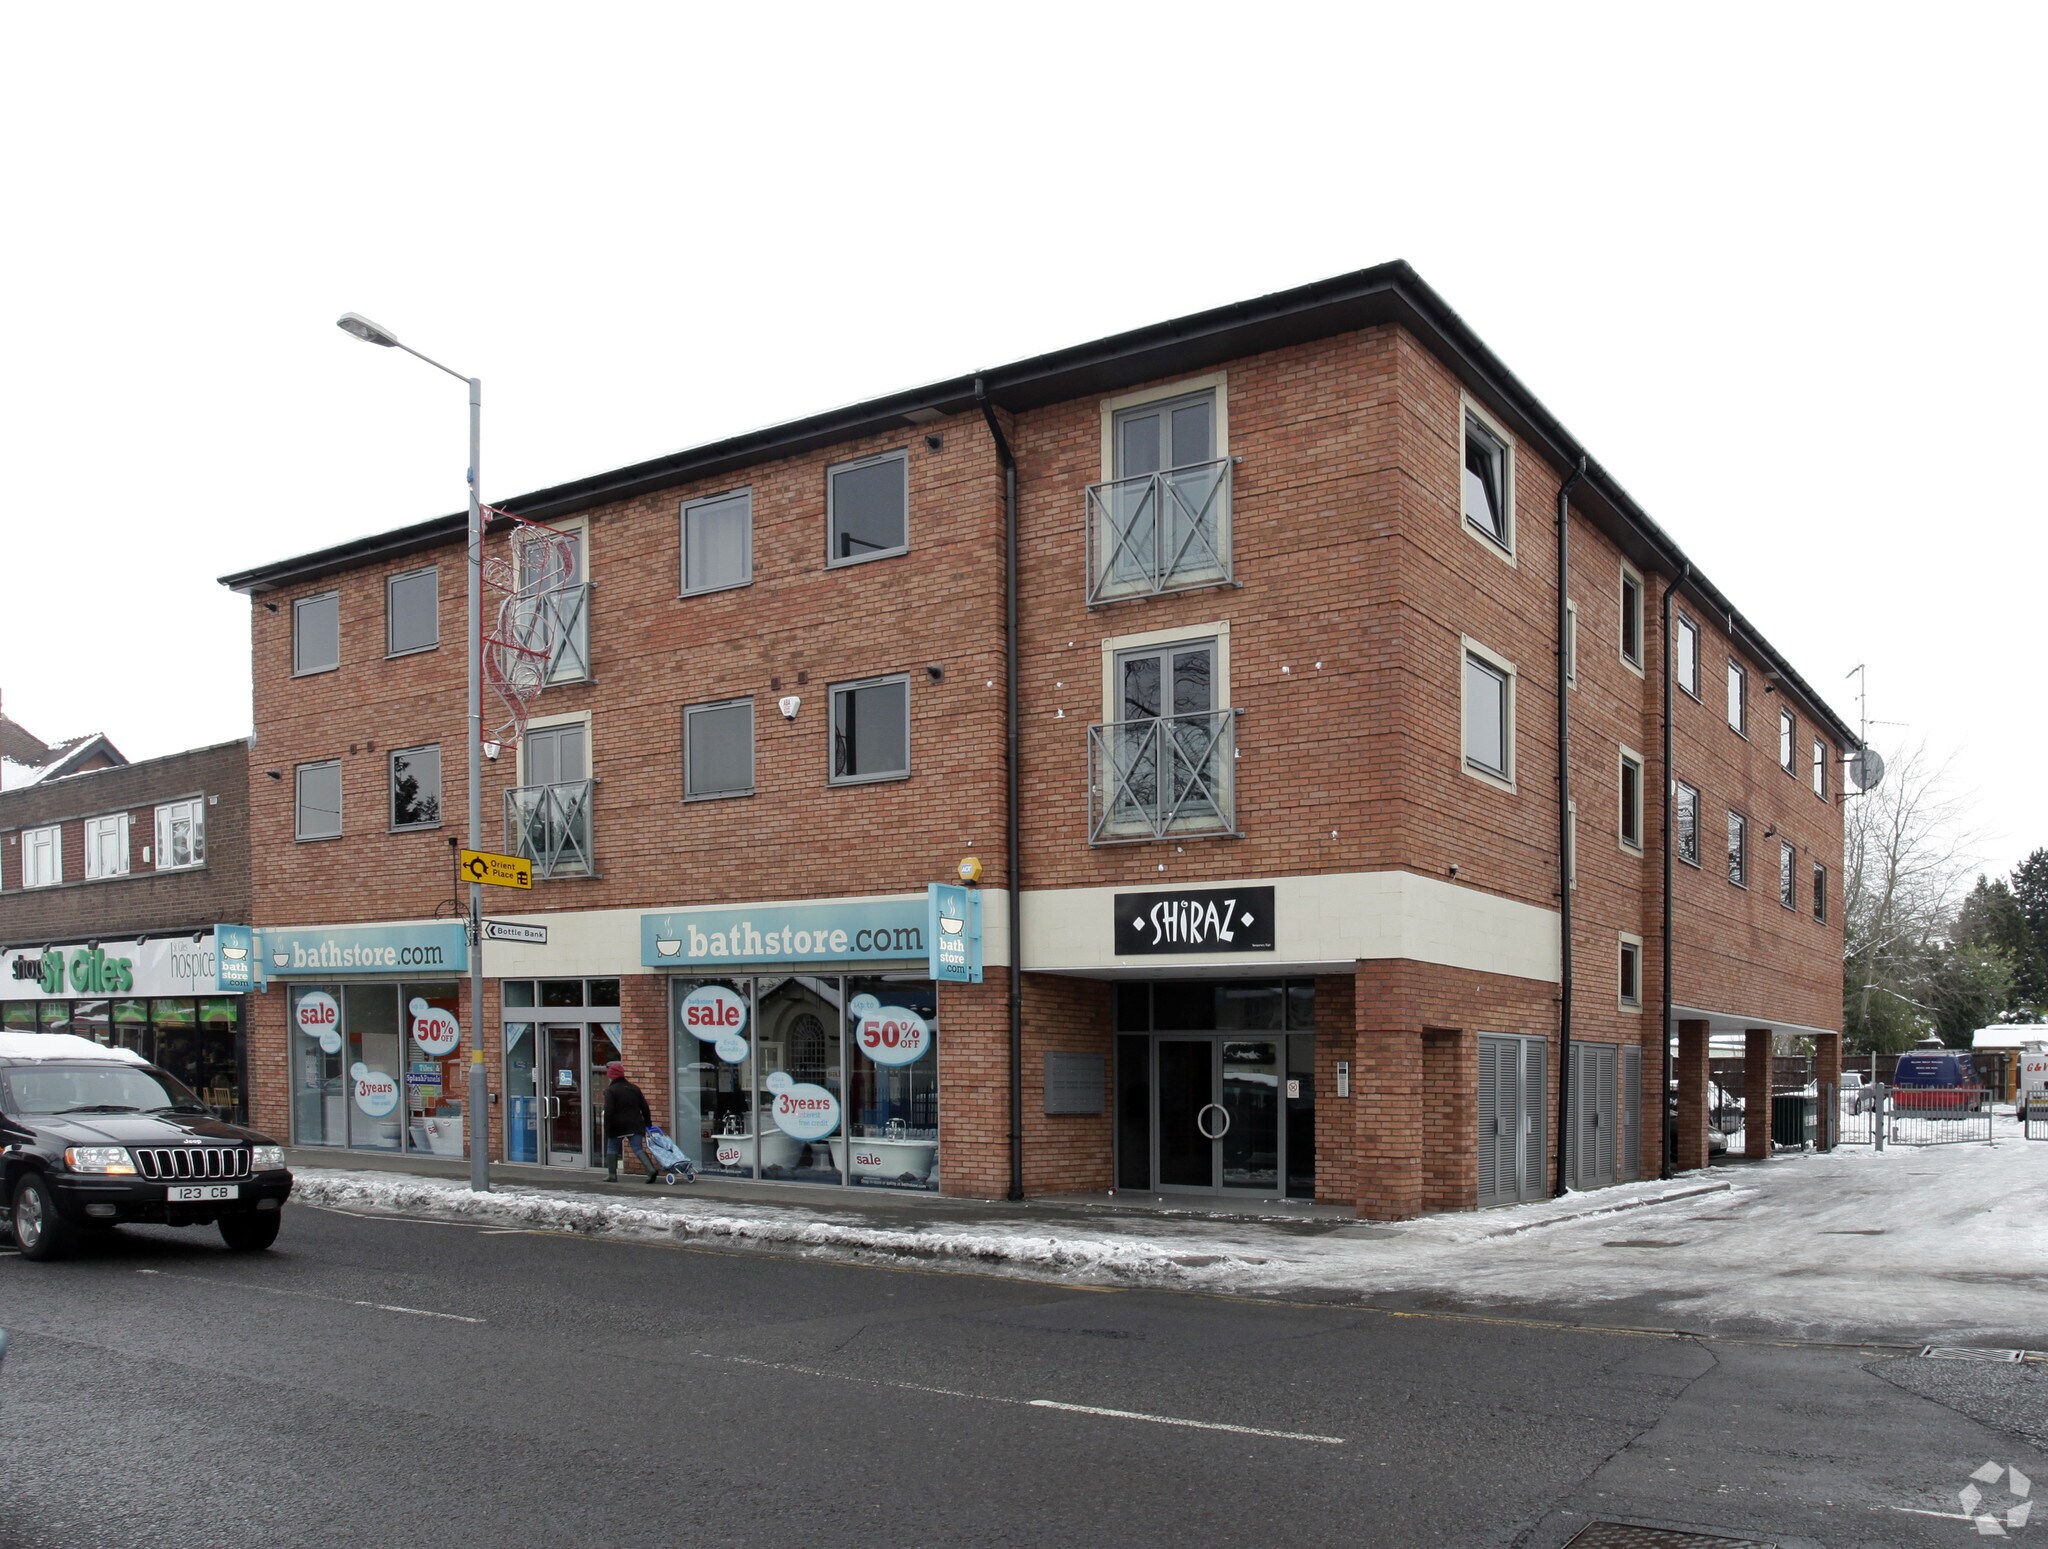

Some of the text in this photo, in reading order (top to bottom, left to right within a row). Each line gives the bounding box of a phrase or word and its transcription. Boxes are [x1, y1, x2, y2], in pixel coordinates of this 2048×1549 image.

[490, 860, 515, 870] Orient
[493, 869, 514, 879] Place
[497, 927, 544, 938] Bottle Bank
[687, 922, 923, 957] bathstore.com
[940, 937, 964, 952] bath
[293, 940, 444, 968] bathstore.com
[940, 953, 964, 964] store
[41, 951, 65, 993] St
[69, 948, 134, 993] Giles
[170, 942, 216, 992] hospice
[221, 962, 248, 972] bath
[946, 964, 966, 974] .com
[222, 972, 249, 980] store
[300, 1002, 335, 1024] sale
[687, 998, 740, 1026] sale
[418, 1020, 453, 1041] 50%
[863, 1021, 920, 1048] 50%
[900, 1040, 920, 1048] OFF
[719, 1148, 740, 1160] sale
[856, 1153, 882, 1165] sale
[180, 1187, 228, 1199] 123 CB
